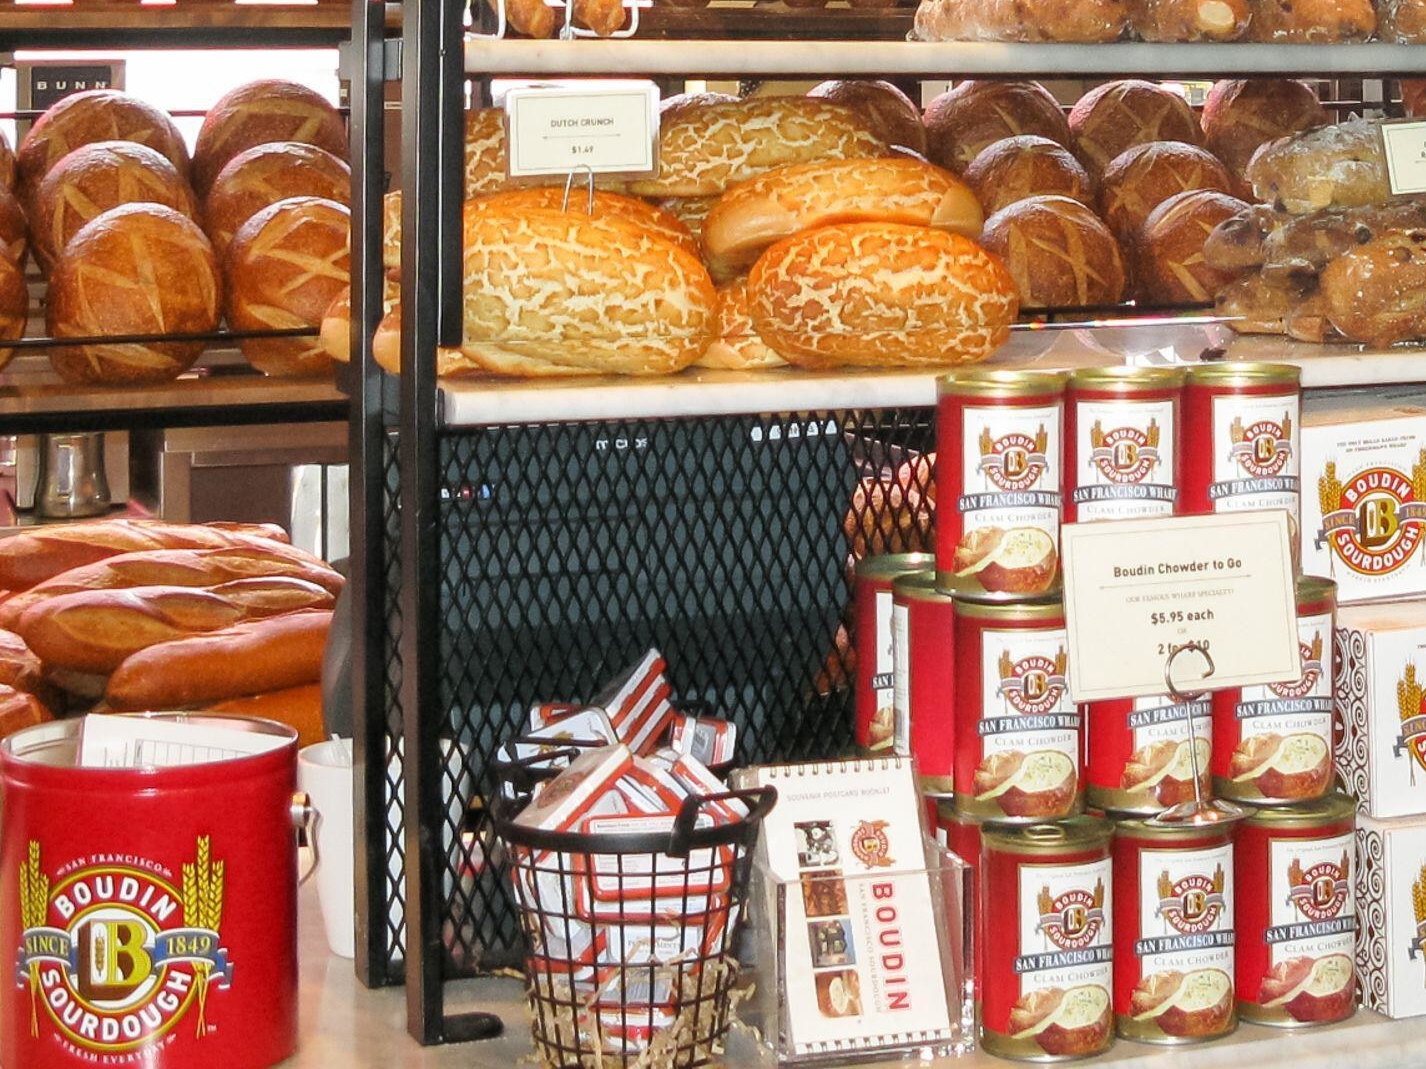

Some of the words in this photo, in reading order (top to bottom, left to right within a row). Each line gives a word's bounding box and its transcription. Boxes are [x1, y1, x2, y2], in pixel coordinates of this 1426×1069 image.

[36, 80, 107, 90] BUNN
[550, 119, 578, 128] DUTCH
[580, 117, 614, 127] CRUNCH
[571, 145, 594, 154] $1.49
[994, 436, 1036, 452] BOUDIN
[1105, 429, 1145, 445] BOUDIN
[989, 466, 1039, 491] SOURDOUGH
[1100, 459, 1150, 482] SOURDOUGH
[1073, 489, 1090, 502] SAN
[1091, 485, 1147, 501] FRANCISCO
[1210, 484, 1228, 498] SAN
[1231, 479, 1283, 494] FRANCISCO
[1344, 472, 1411, 503] BOUDIN
[959, 495, 978, 510] SAN
[979, 492, 1036, 508] FRANCISCO
[1337, 526, 1419, 570] SOURDOUGH
[1113, 564, 1155, 578] Boudin
[1157, 560, 1209, 574] Chowder
[1213, 560, 1224, 570] to
[1227, 557, 1242, 569] Go
[1151, 611, 1184, 625] $5.95
[1187, 609, 1214, 622] each
[1158, 643, 1165, 655] 2
[1014, 658, 1055, 674] BOUDIN
[873, 676, 888, 687] SAN
[1009, 688, 1059, 713] SOURDOUGH
[1236, 703, 1254, 717] SAN
[1257, 699, 1312, 715] FRANCISCO
[979, 720, 997, 734] SAN
[999, 715, 1056, 731] FRANCISCO
[1129, 712, 1151, 727] SAN
[994, 736, 1025, 746] CLAM
[1028, 734, 1072, 746] CHOWDER
[65, 856, 87, 871] SAN
[92, 853, 162, 873] FRANCISCO
[54, 875, 178, 922] BOUDIN
[1055, 892, 1093, 910] BOUDIN
[1168, 906, 1217, 933] SOURDOUGH
[1266, 928, 1287, 942] SAN
[1290, 919, 1342, 939] FRANCISCO
[25, 934, 69, 956] SINCE
[167, 935, 211, 955] 1849
[873, 883, 909, 1012] BOUDIN
[1136, 940, 1156, 954] SAN
[1158, 933, 1214, 952] FRANCISCO
[1016, 957, 1038, 971] SAN
[1039, 950, 1095, 969] FRANCISCO
[42, 968, 192, 1042] SOURDOUGH
[62, 1040, 98, 1063] FRESH
[103, 1039, 167, 1064] EVERYDAY
